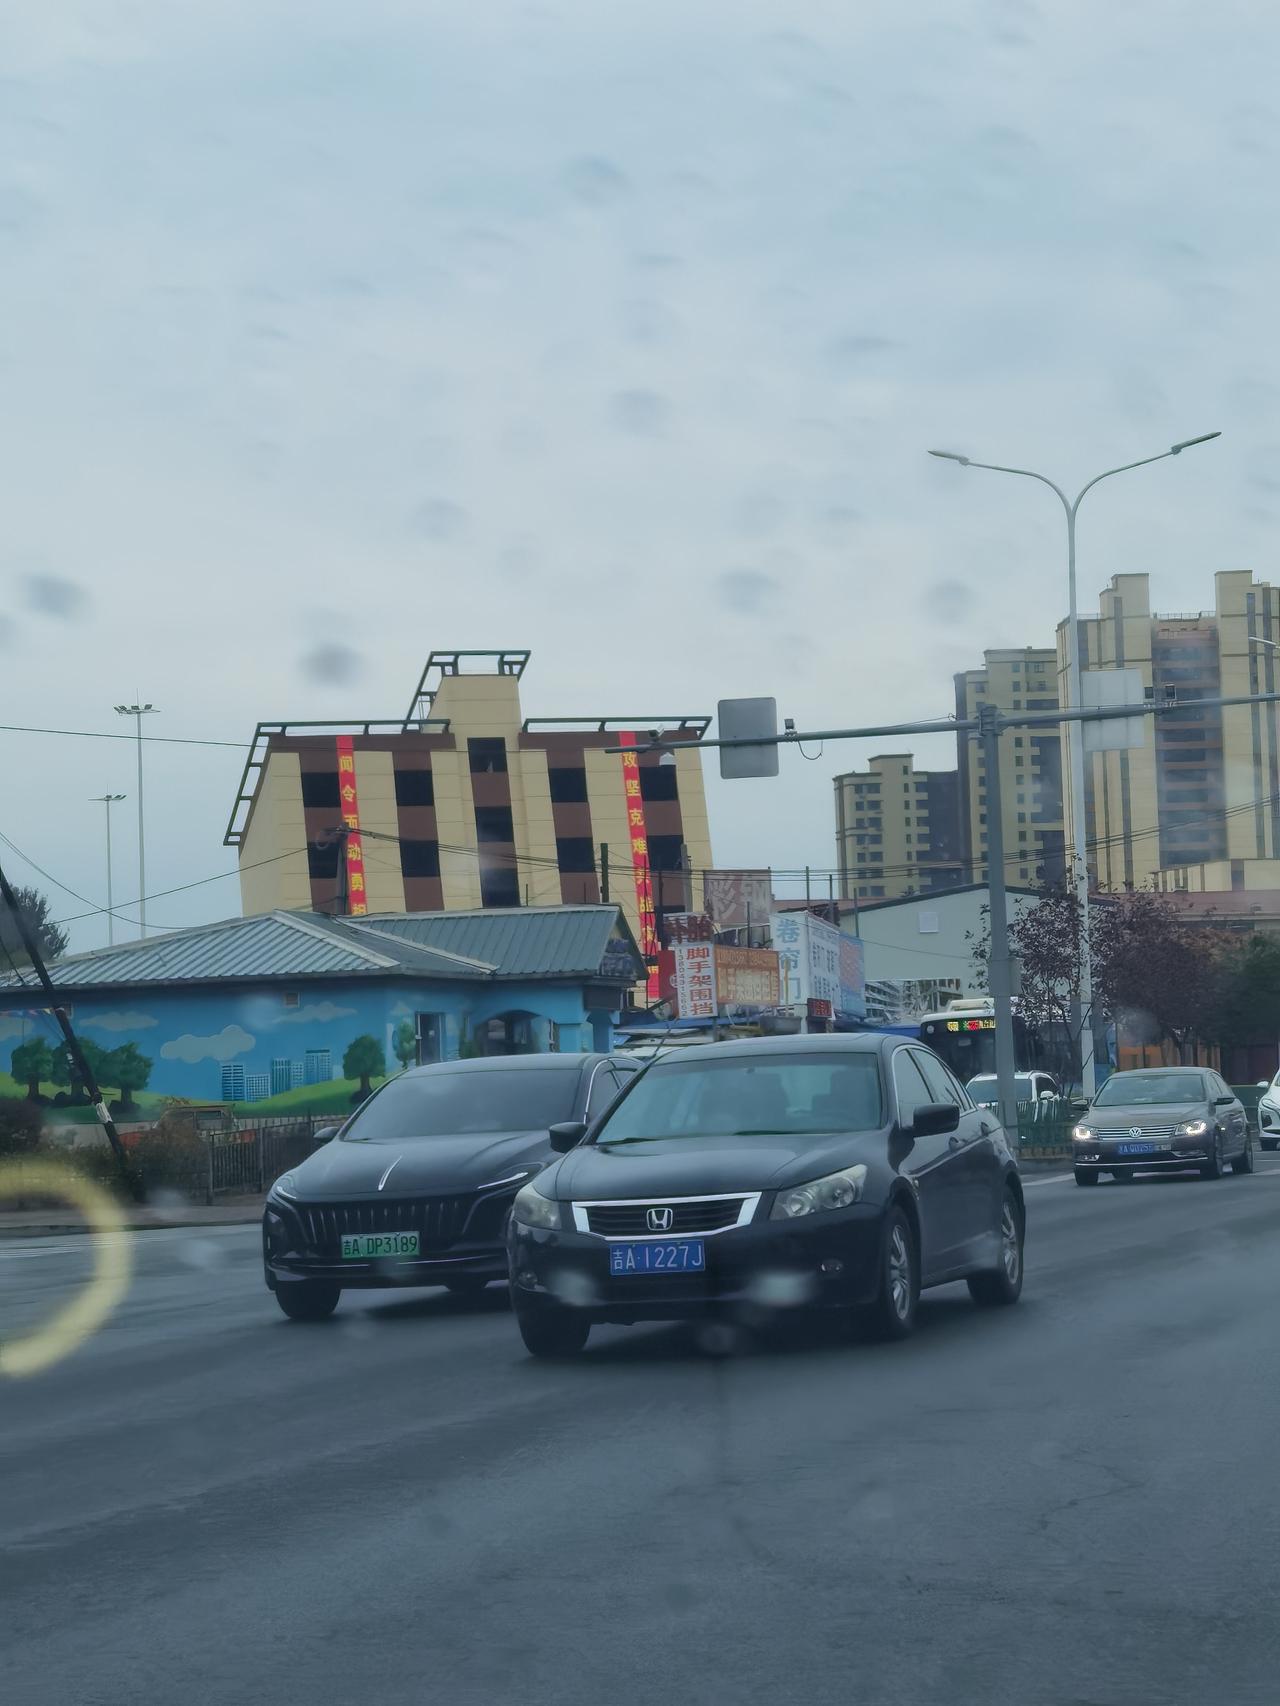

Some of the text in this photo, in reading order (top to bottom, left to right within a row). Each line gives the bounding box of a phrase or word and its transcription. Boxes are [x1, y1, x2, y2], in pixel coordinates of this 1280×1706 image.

[687, 947, 713, 1015] 脚手架围挡
[776, 918, 800, 999] 卷帘门
